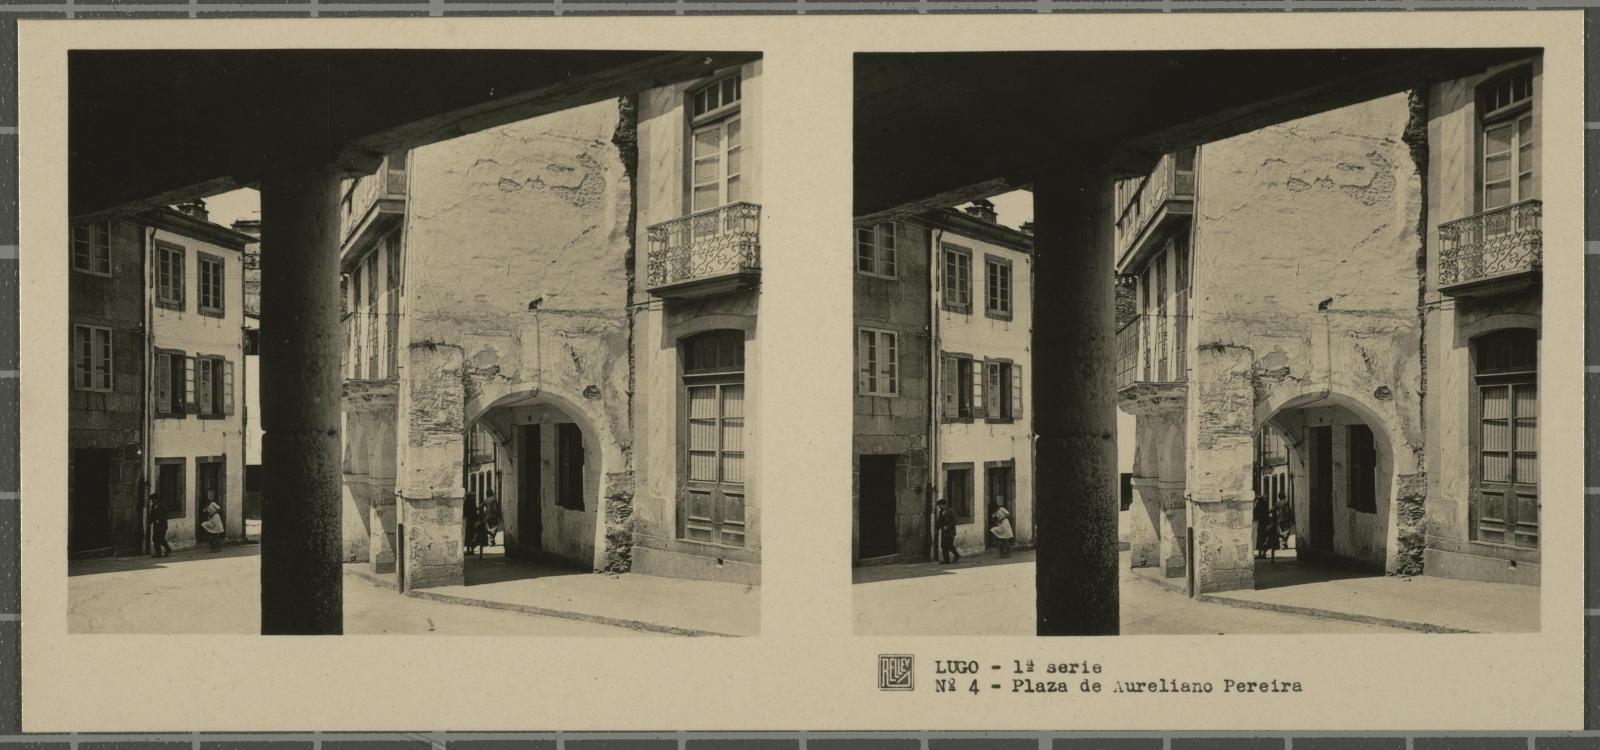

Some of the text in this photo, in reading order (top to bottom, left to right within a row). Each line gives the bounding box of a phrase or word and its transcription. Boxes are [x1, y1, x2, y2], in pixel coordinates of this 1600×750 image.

[935, 660, 979, 674] LUGO
[1046, 660, 1102, 674] serie
[968, 679, 980, 695] 4
[1012, 678, 1068, 693] Plaza
[1080, 678, 1102, 693] de
[1113, 678, 1213, 693] Aureliano
[1223, 679, 1303, 693] Pereira
